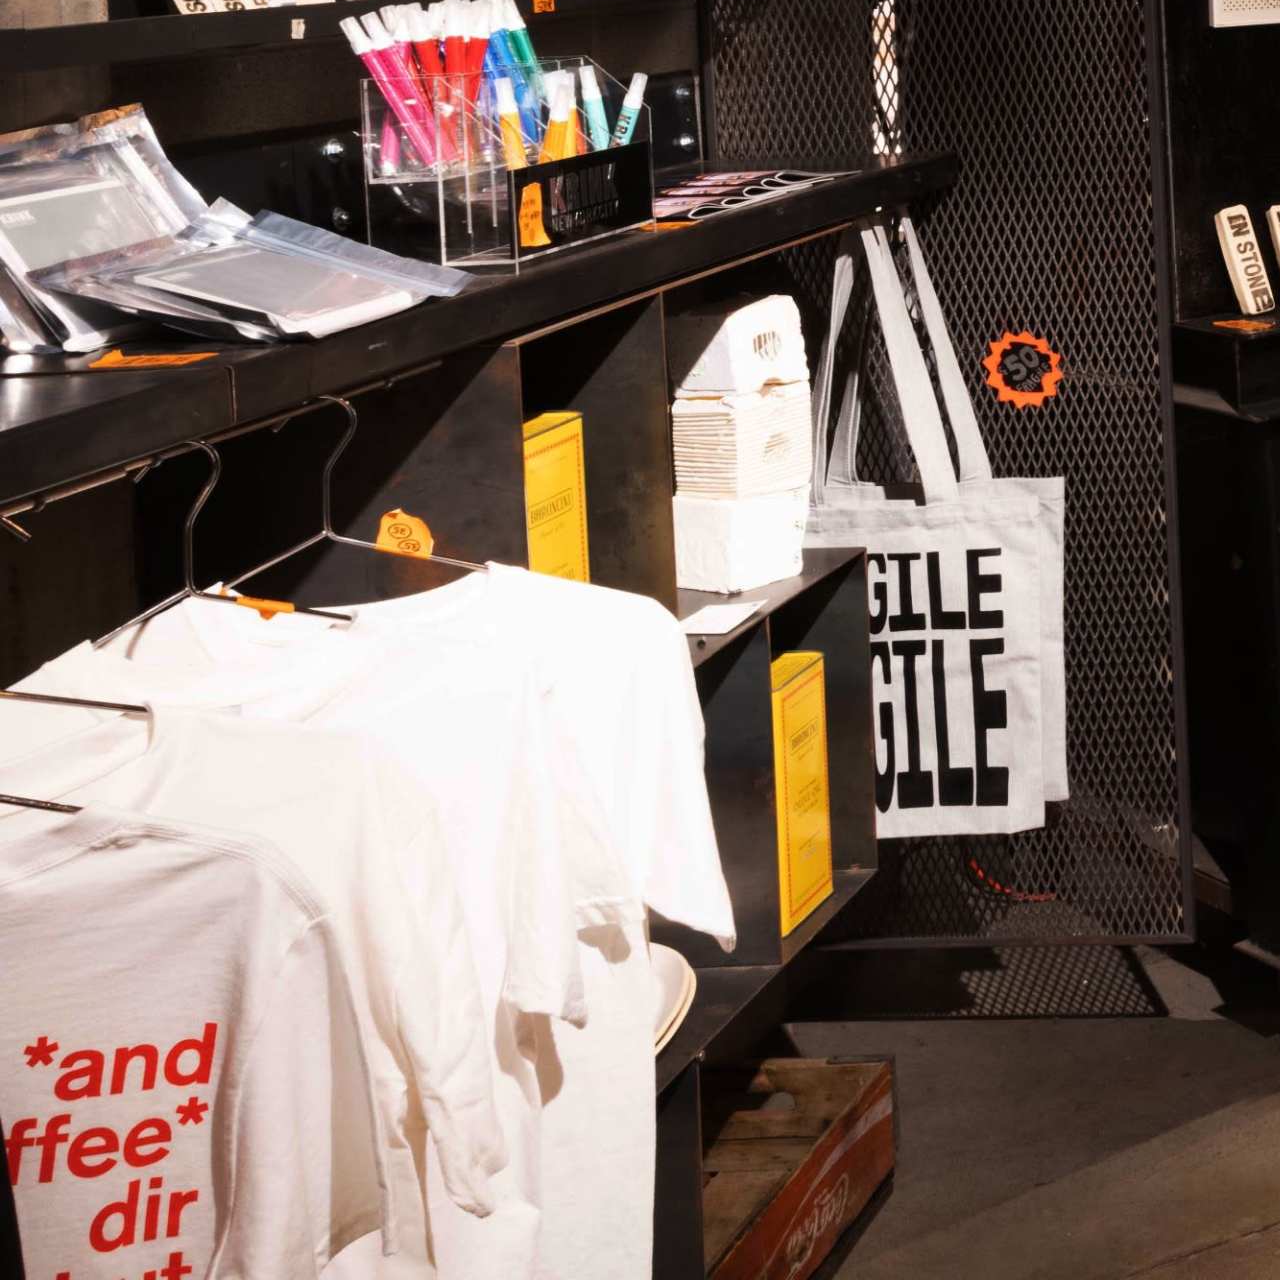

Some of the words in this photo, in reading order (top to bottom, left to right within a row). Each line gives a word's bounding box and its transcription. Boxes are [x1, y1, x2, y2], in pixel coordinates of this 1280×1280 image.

[1227, 213, 1249, 237] IN
[1237, 241, 1274, 312] STONE
[89, 1176, 199, 1253] dir
